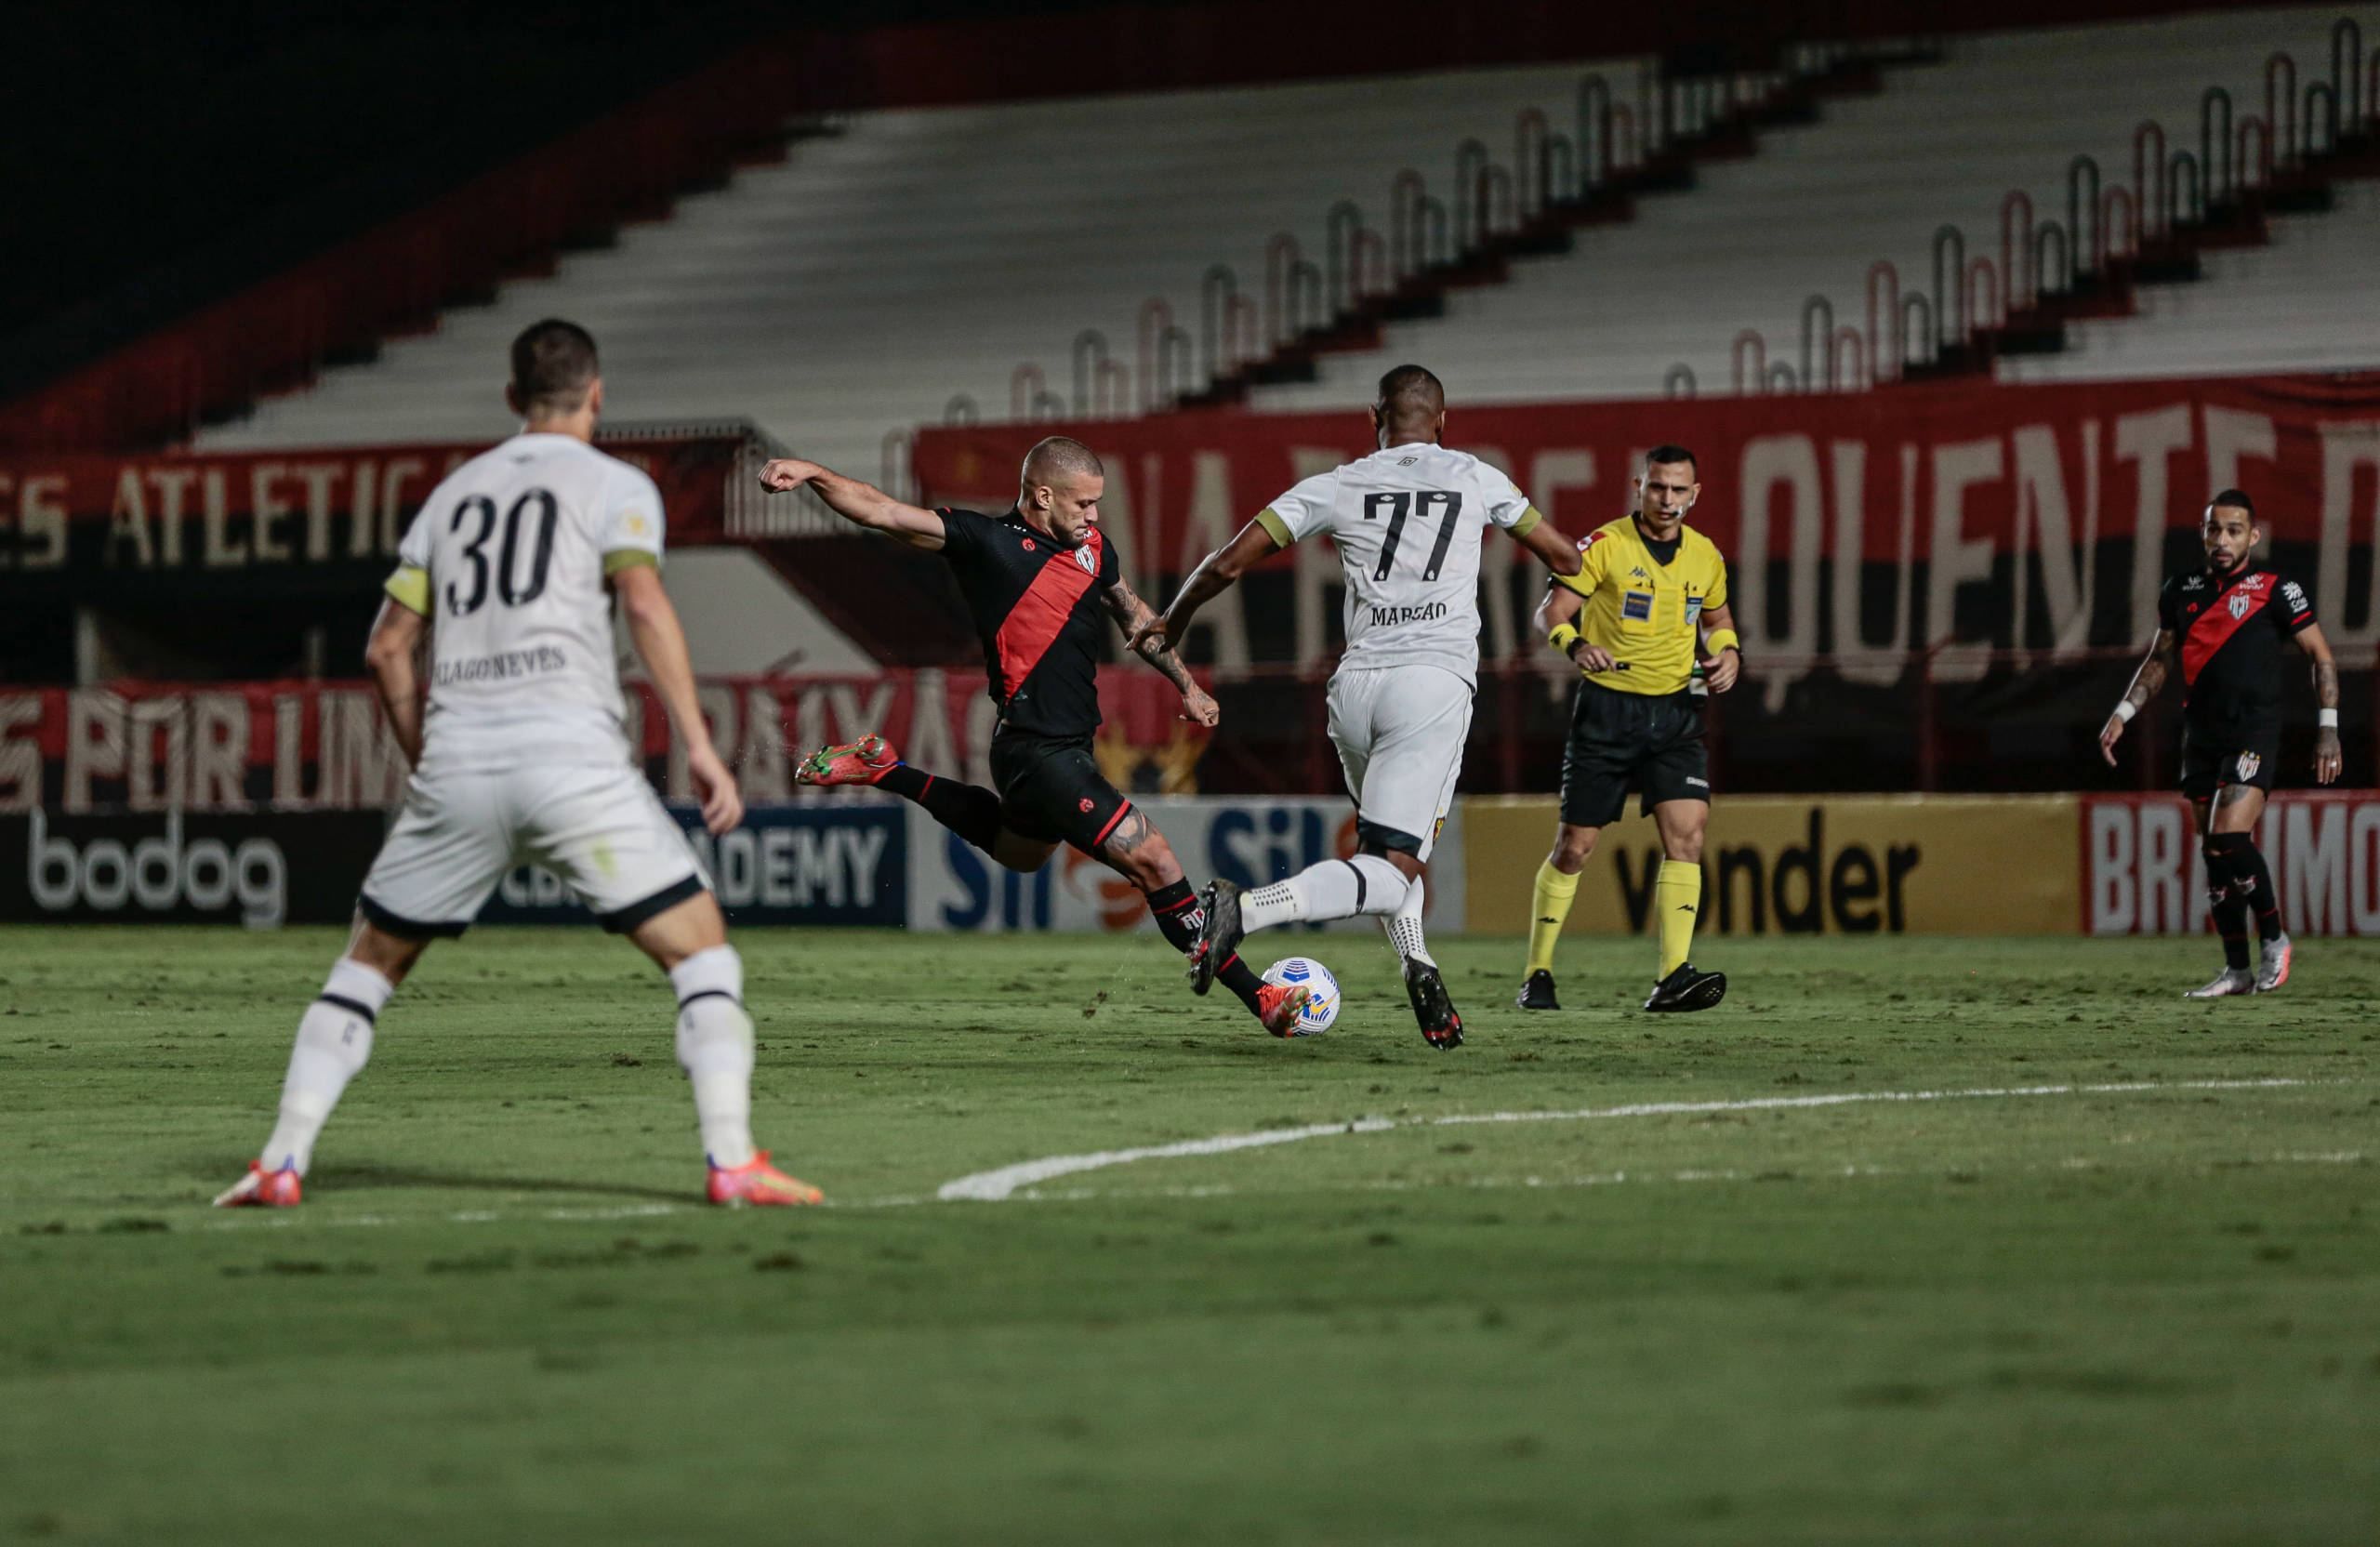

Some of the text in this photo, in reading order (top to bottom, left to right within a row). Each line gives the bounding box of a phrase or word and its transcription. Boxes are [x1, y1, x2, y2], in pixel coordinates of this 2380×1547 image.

[104, 450, 472, 565] ATLETIC
[444, 485, 560, 617] 30
[1364, 491, 1462, 582] 77
[433, 644, 566, 686] IAGONEVES
[62, 690, 257, 814] POR
[28, 802, 287, 930] bodog
[1615, 805, 1921, 935] vnder
